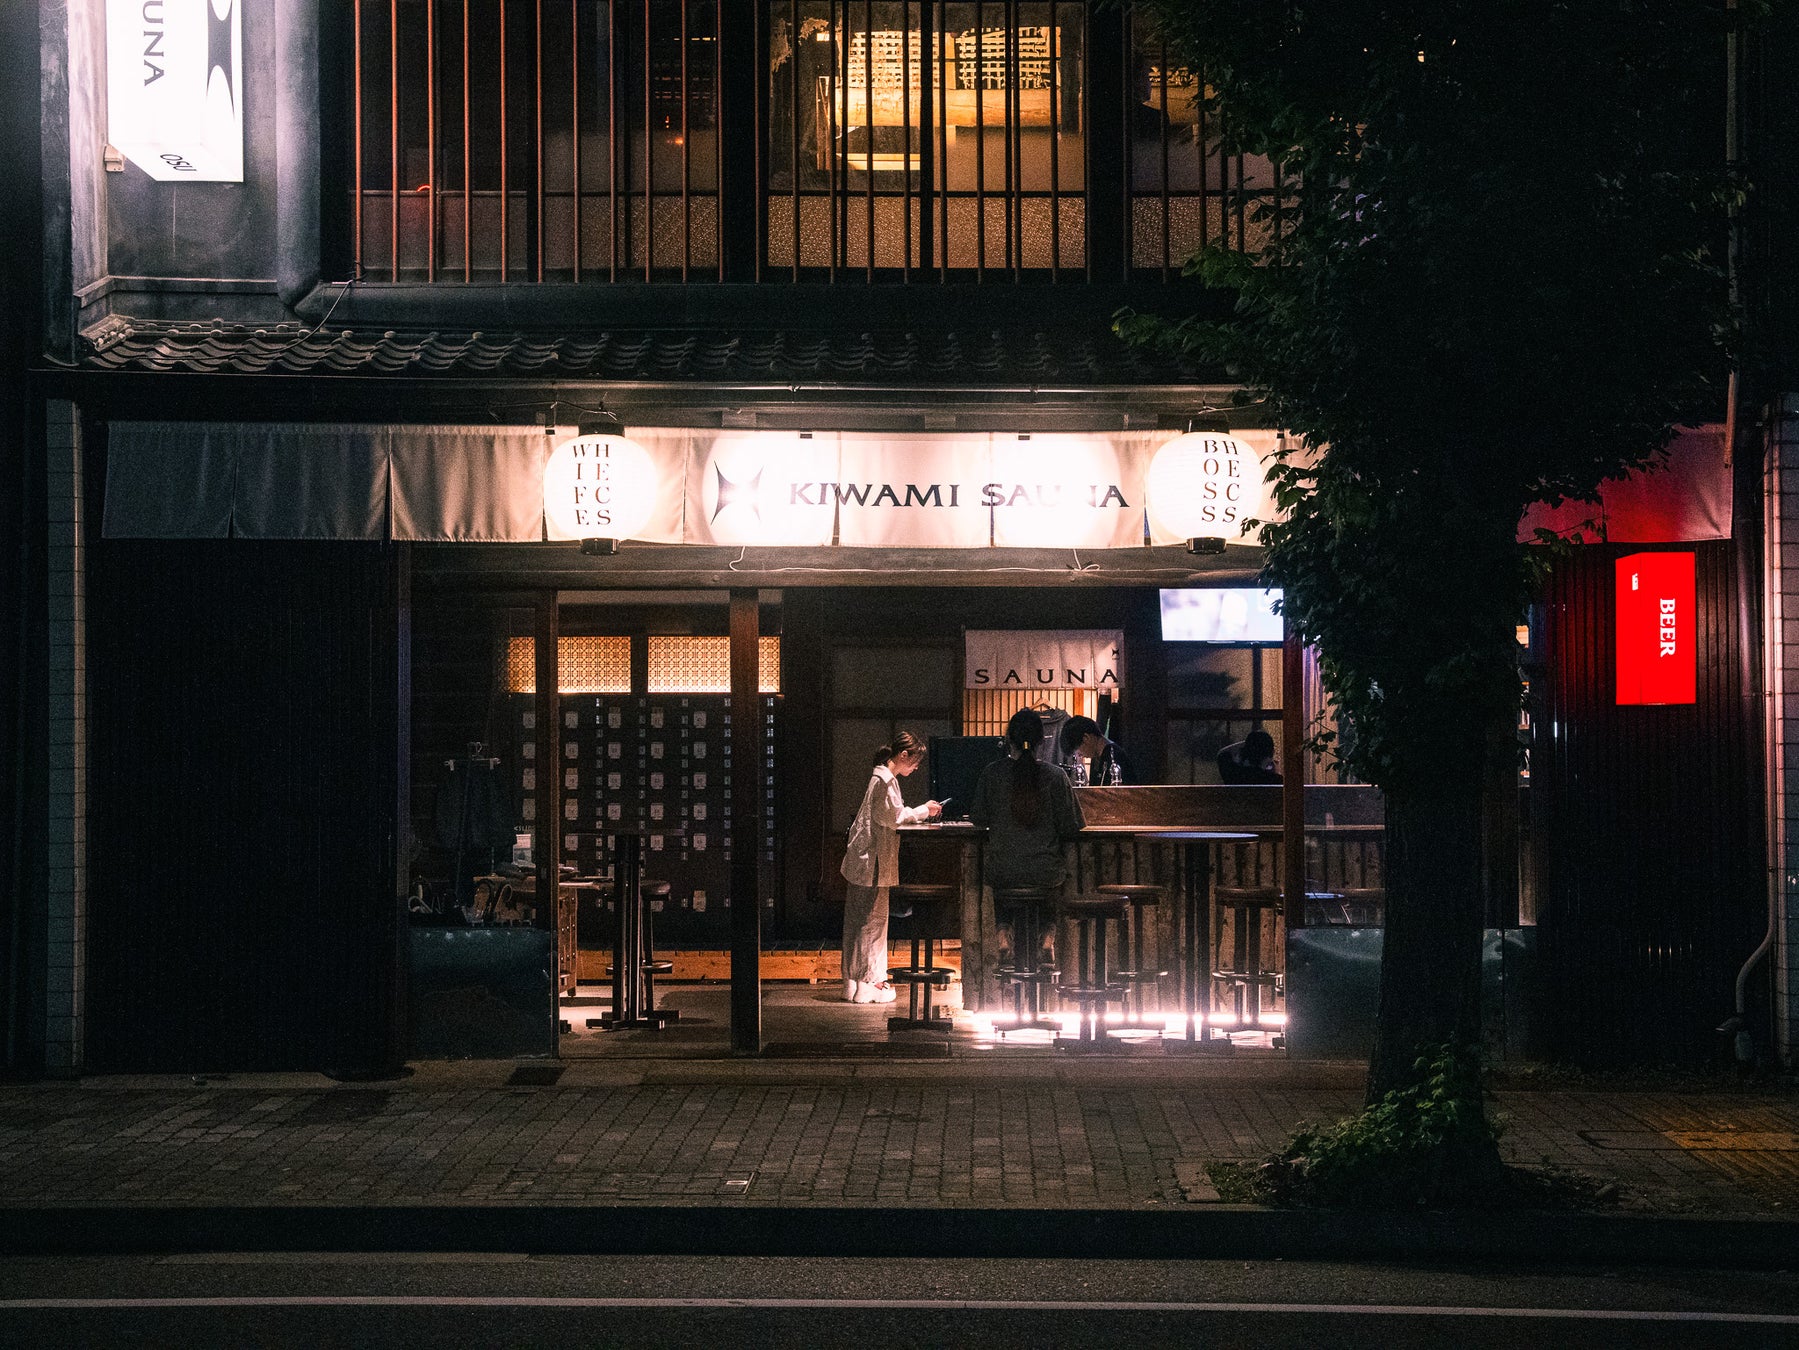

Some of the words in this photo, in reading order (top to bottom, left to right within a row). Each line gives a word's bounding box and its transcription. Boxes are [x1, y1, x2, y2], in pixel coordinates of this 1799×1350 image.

[789, 482, 959, 507] KIWAMI
[1660, 598, 1676, 657] BEER
[974, 669, 1119, 684] SAUNA
